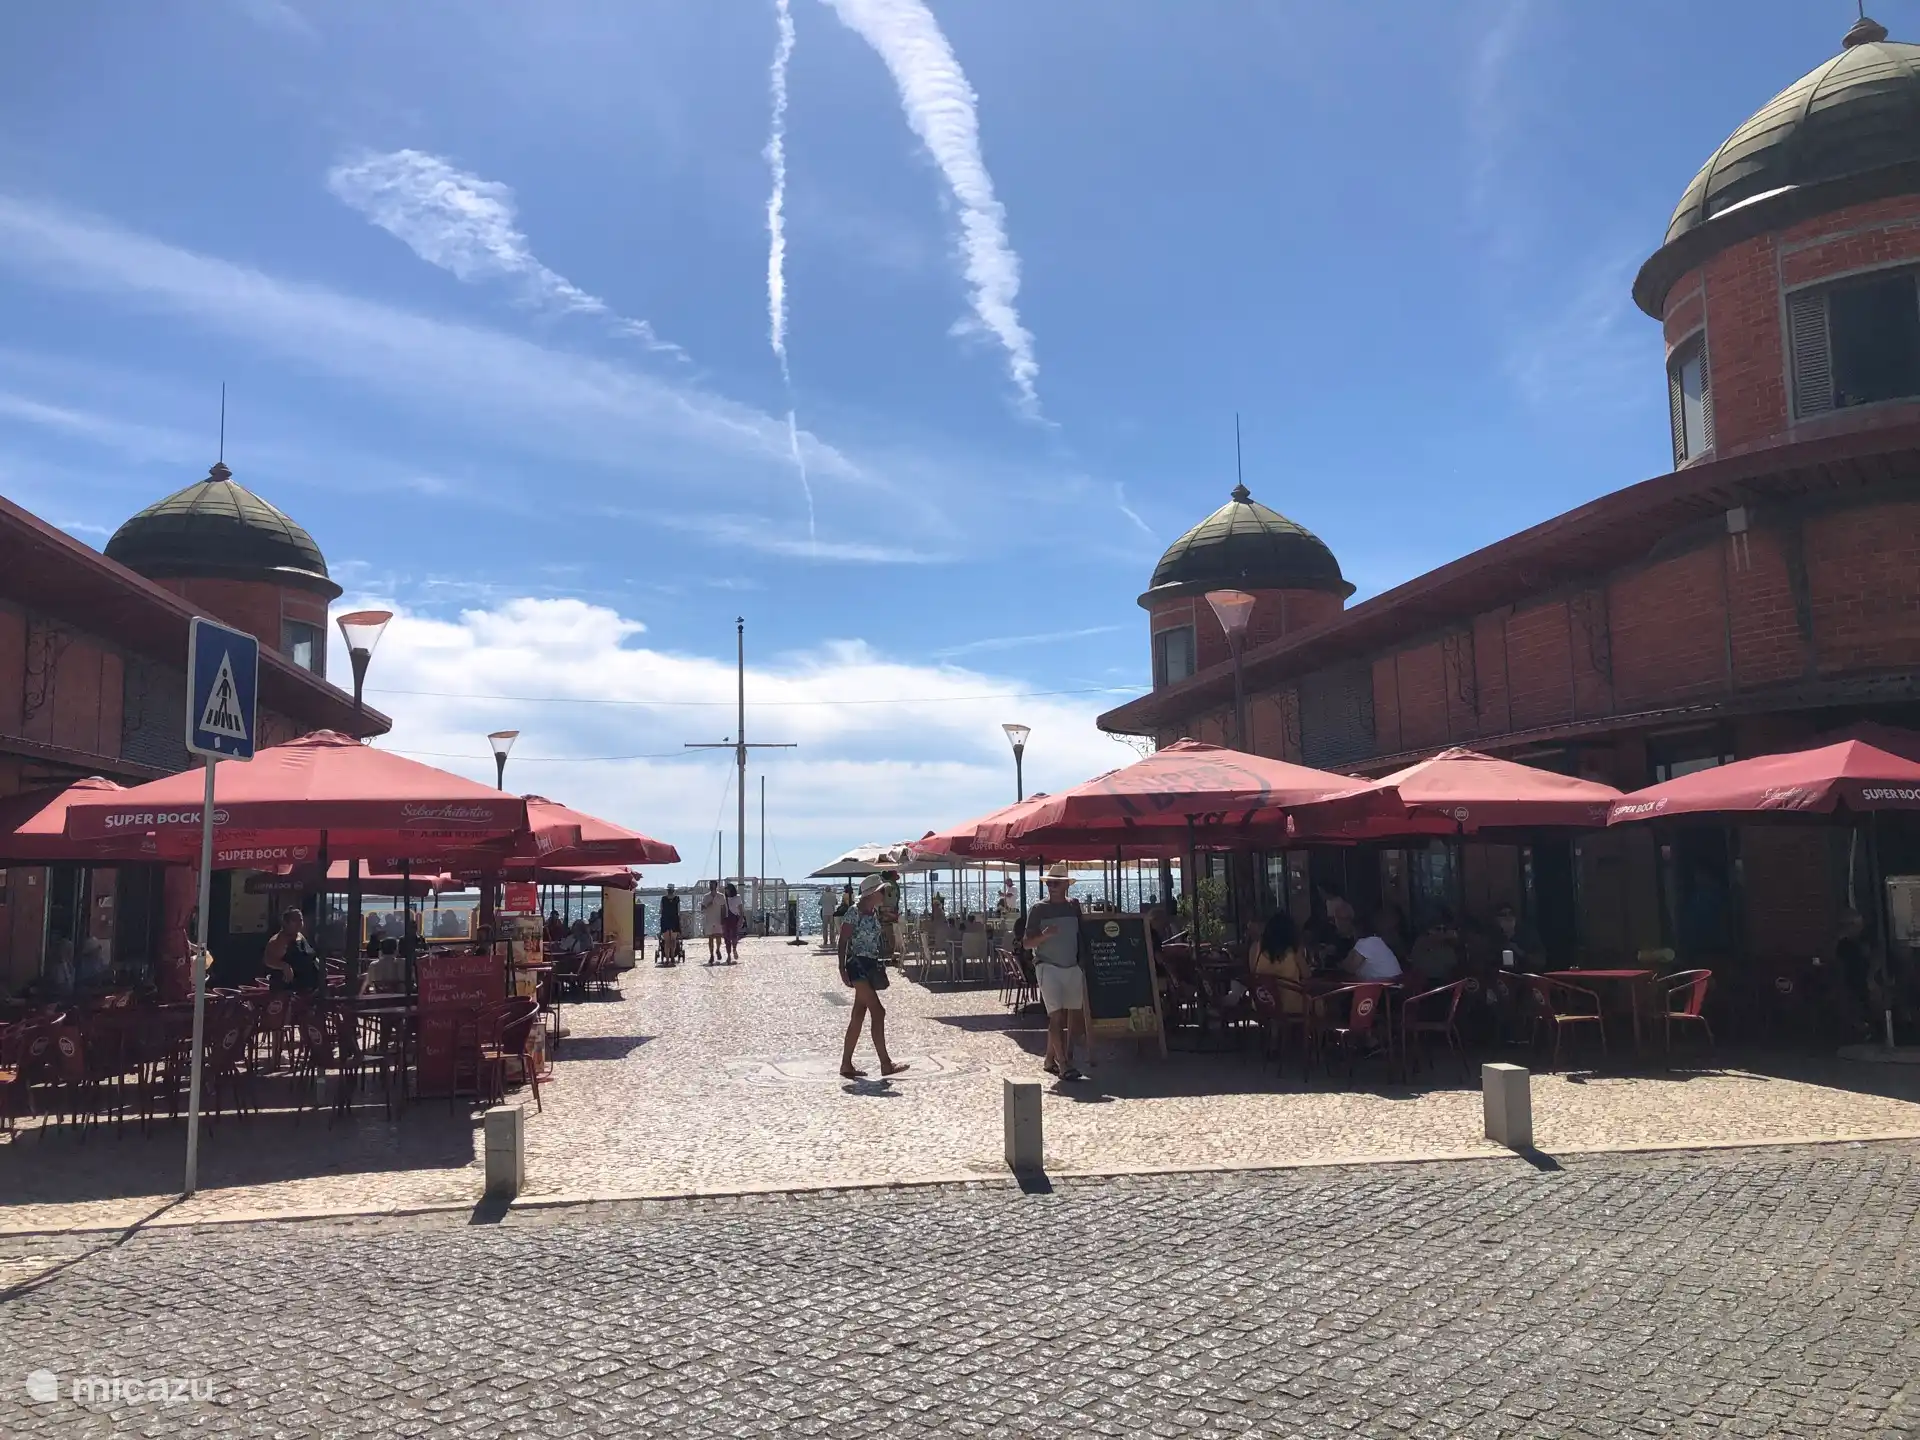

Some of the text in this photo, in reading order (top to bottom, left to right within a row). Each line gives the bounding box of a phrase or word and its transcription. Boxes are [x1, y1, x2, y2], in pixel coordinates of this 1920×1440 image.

[1862, 788, 1899, 800] SUPER
[401, 803, 439, 818] Sabor
[1613, 804, 1636, 817] SUPER
[1636, 800, 1656, 814] BOCK
[104, 813, 154, 828] SUPER
[157, 812, 200, 825] BOCK
[217, 850, 254, 861] SUPER
[256, 848, 287, 859] BOCK
